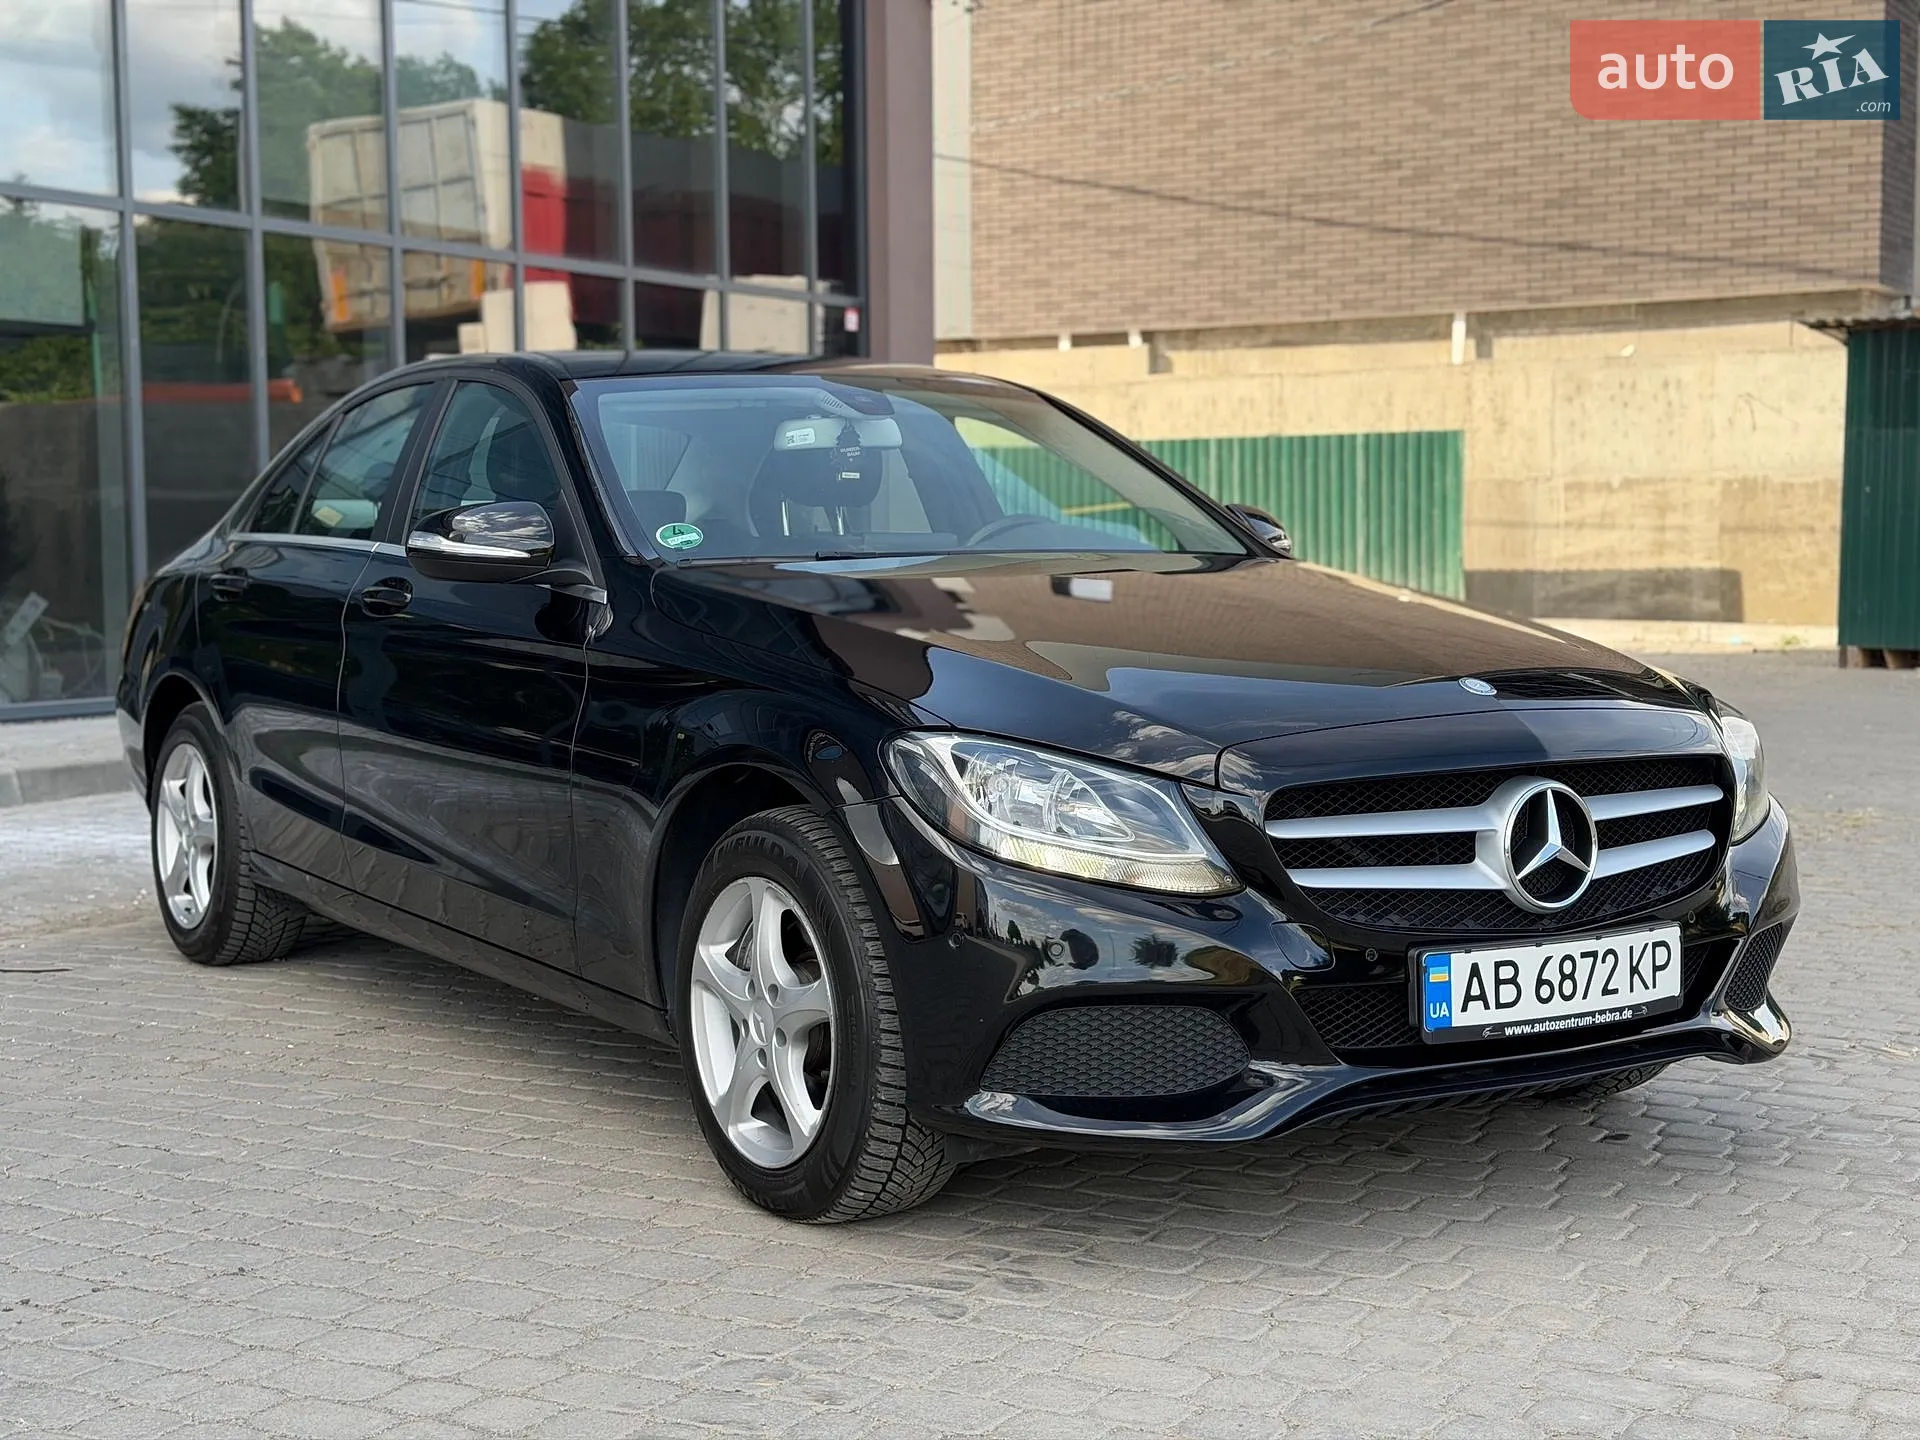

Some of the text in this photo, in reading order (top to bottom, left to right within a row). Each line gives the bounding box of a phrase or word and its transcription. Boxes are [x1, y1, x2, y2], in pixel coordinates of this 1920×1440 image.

[1460, 940, 1672, 1013] AB 6872 KP
[1429, 1001, 1450, 1018] UA
[1504, 1007, 1633, 1036] www.autozentrum-bebra.de
